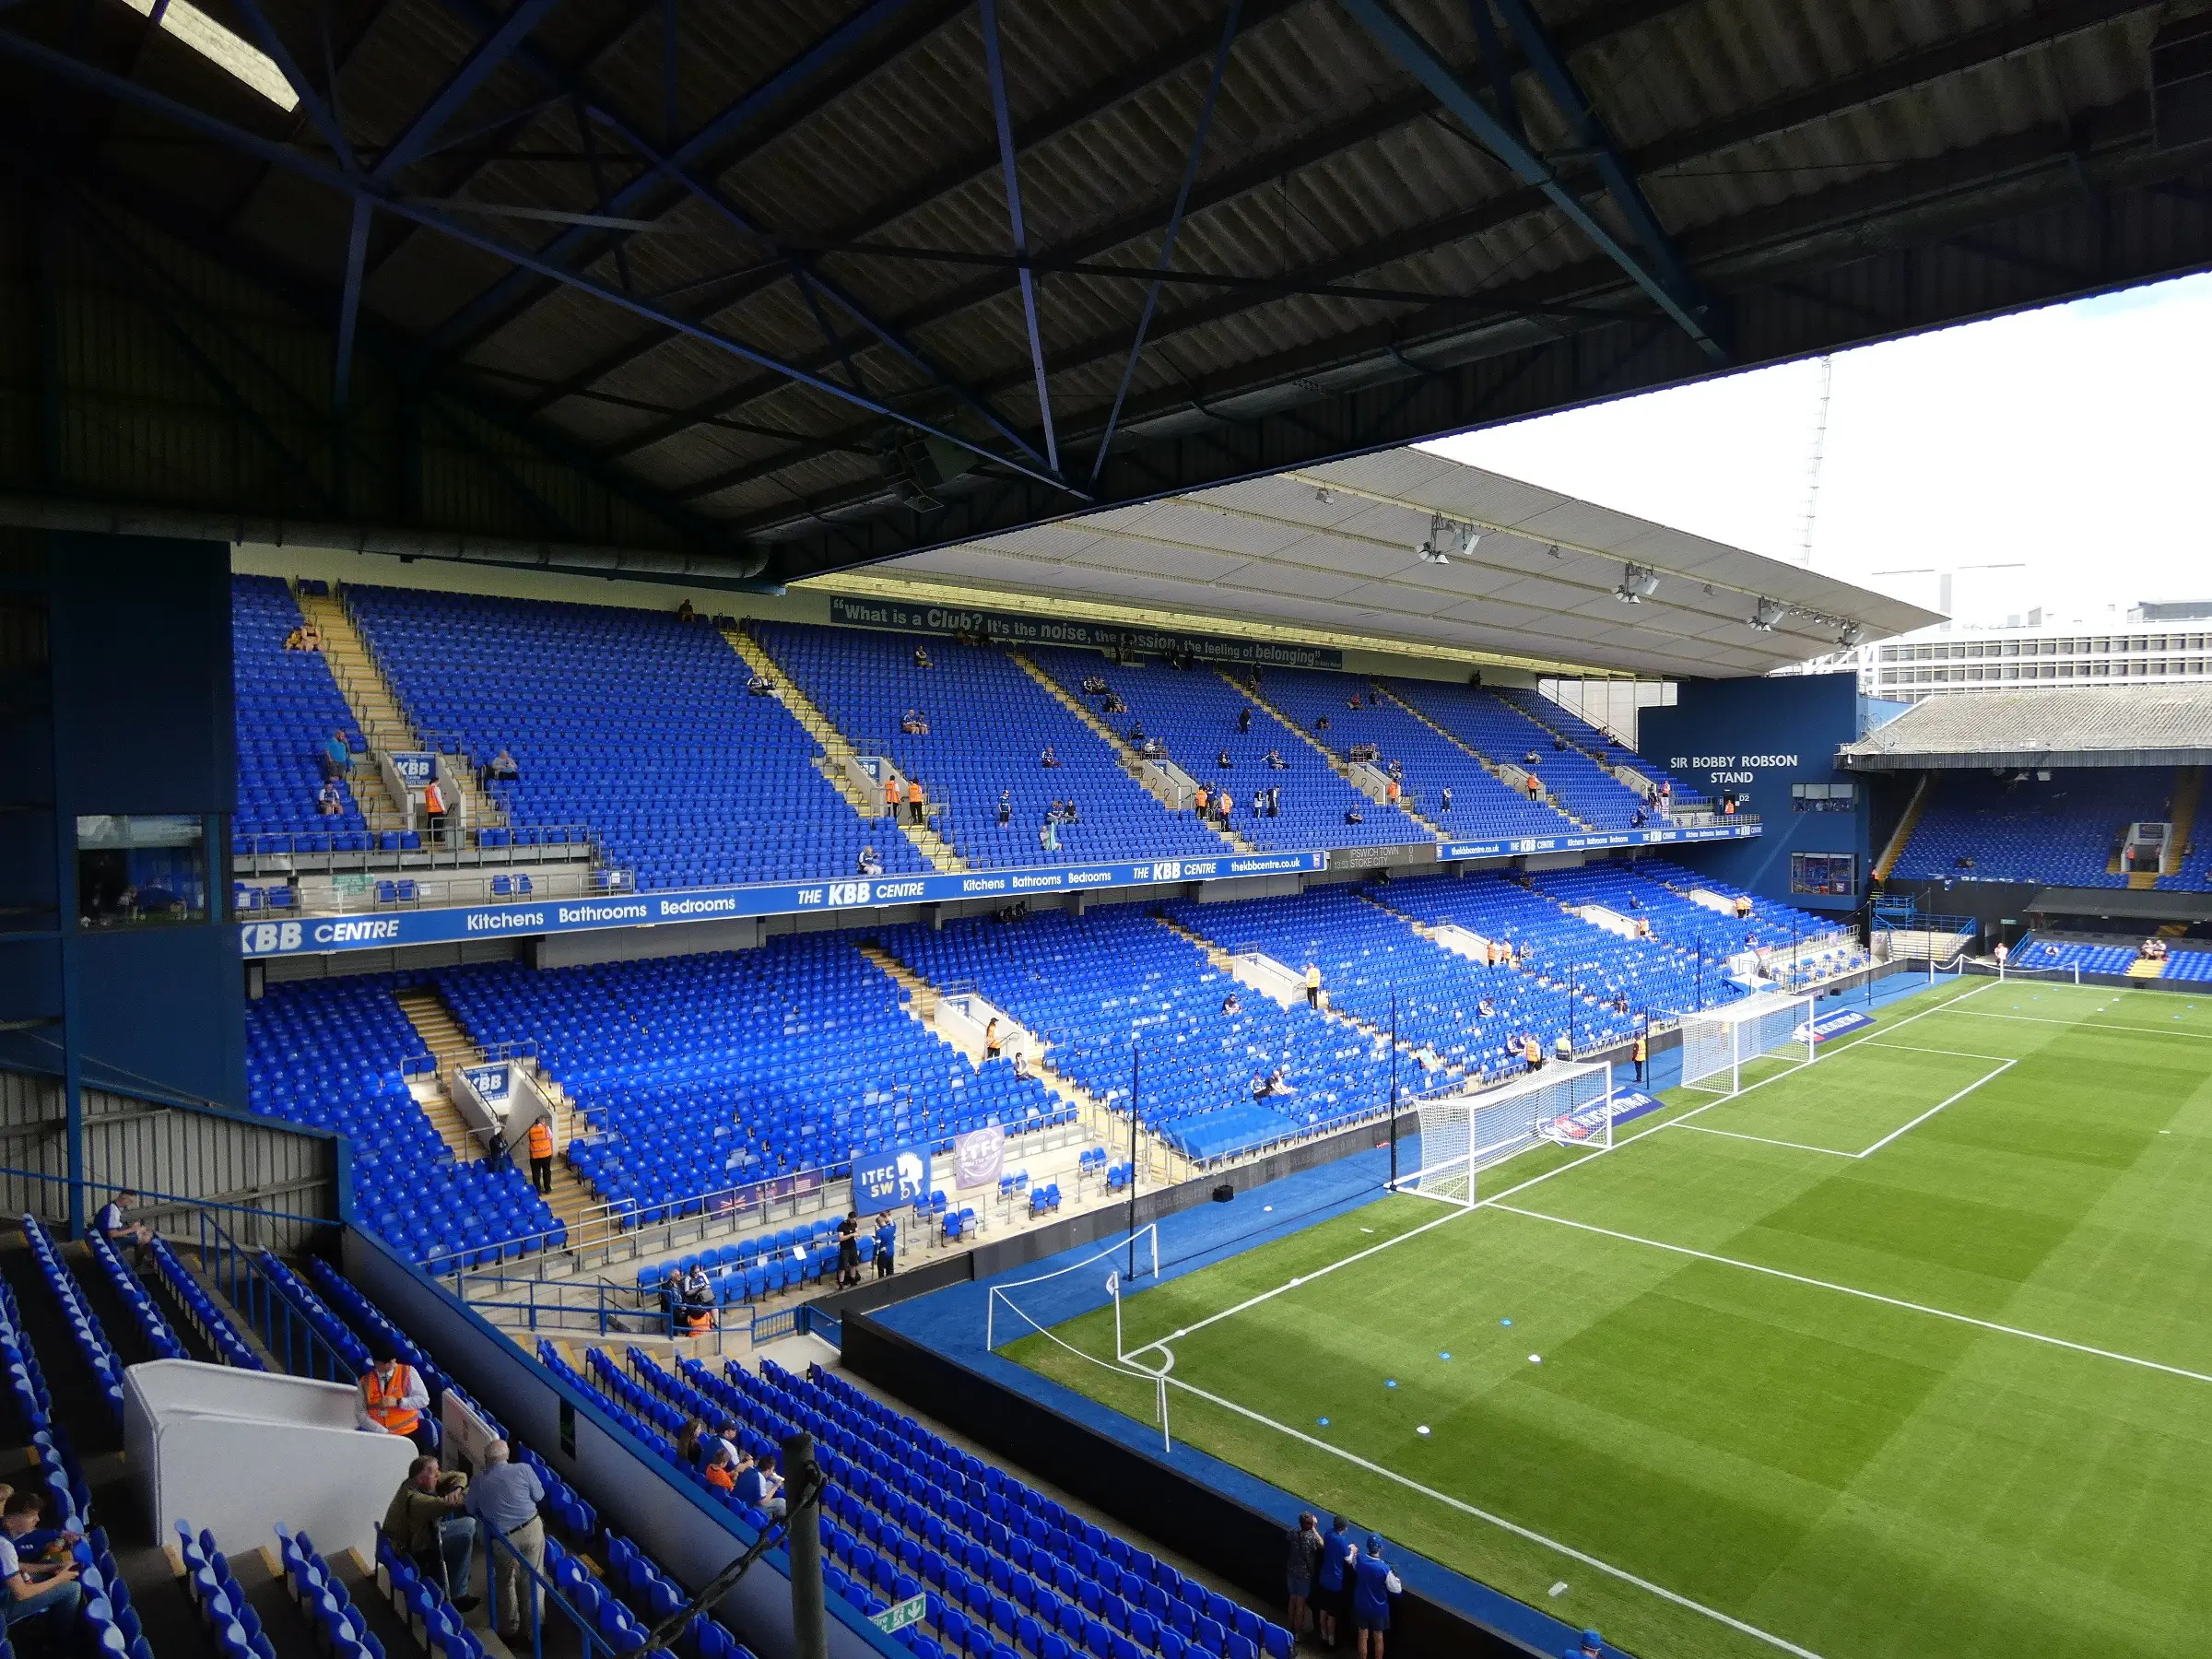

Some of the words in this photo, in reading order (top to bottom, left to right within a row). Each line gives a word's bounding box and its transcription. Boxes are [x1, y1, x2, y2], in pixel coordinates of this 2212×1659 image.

[893, 609, 907, 624] is
[912, 614, 922, 626] a
[927, 608, 983, 630] Club?
[987, 618, 1010, 634] It's
[1014, 622, 1037, 637] the
[1041, 622, 1091, 644] noise,
[1095, 629, 1117, 643] the
[1205, 641, 1240, 658] feeling
[1243, 645, 1253, 658] of
[397, 761, 429, 775] KBB
[1670, 757, 1688, 769] SIR
[1692, 756, 1735, 768] BOBBY
[1741, 755, 1798, 767] ROBSON
[1711, 771, 1754, 783] STAND
[1380, 846, 1399, 856] TOWN
[1511, 842, 1519, 851] THE
[1521, 840, 1536, 852] KBB
[1537, 840, 1555, 849] CENTRE
[1231, 857, 1300, 872] thekbbcentre.co.uk
[1350, 858, 1372, 868] STOKE
[1373, 856, 1388, 866] CITY
[1134, 867, 1149, 879] THE
[1153, 863, 1181, 880] KBB
[1184, 863, 1216, 876] CENTRE
[963, 877, 1005, 892] Kitchens
[1013, 874, 1062, 888] Bathrooms
[1068, 870, 1112, 884] Bedrooms
[798, 888, 822, 904] THE
[829, 882, 870, 905] KBB
[876, 882, 924, 899] CENTRE
[467, 911, 544, 931] Kitchens
[559, 904, 647, 924] Bathrooms
[661, 898, 735, 915] Bedrooms
[314, 920, 399, 944] CENTRE
[861, 1165, 894, 1186] ITFC
[870, 1181, 894, 1198] SW
